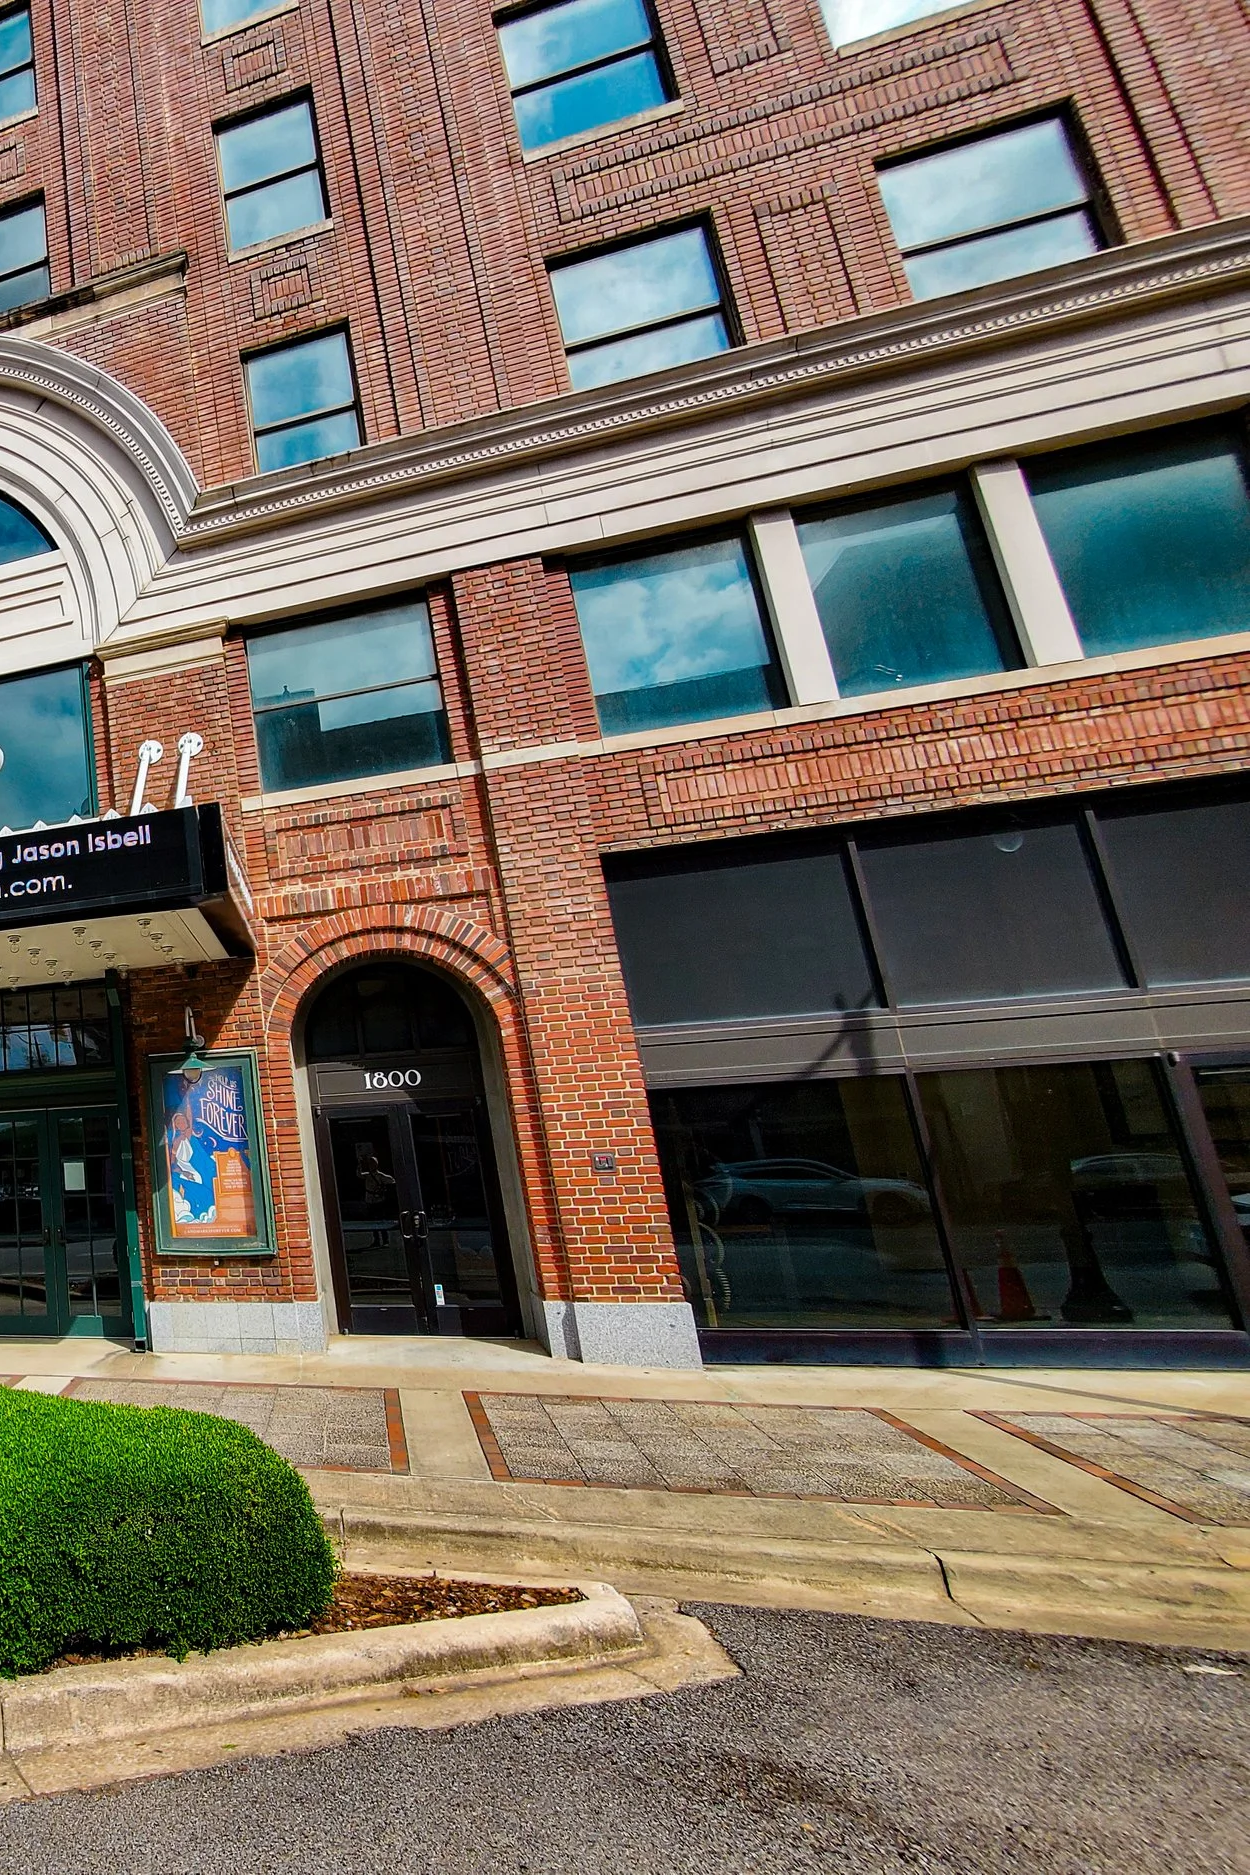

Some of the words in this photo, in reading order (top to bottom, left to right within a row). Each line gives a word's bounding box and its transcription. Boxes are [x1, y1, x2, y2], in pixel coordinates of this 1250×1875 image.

[12, 839, 80, 864] Jason
[87, 824, 151, 853] Isbell
[206, 1079, 244, 1112] SHINE
[363, 1069, 422, 1090] 1800
[199, 1097, 248, 1139] FOREVER
